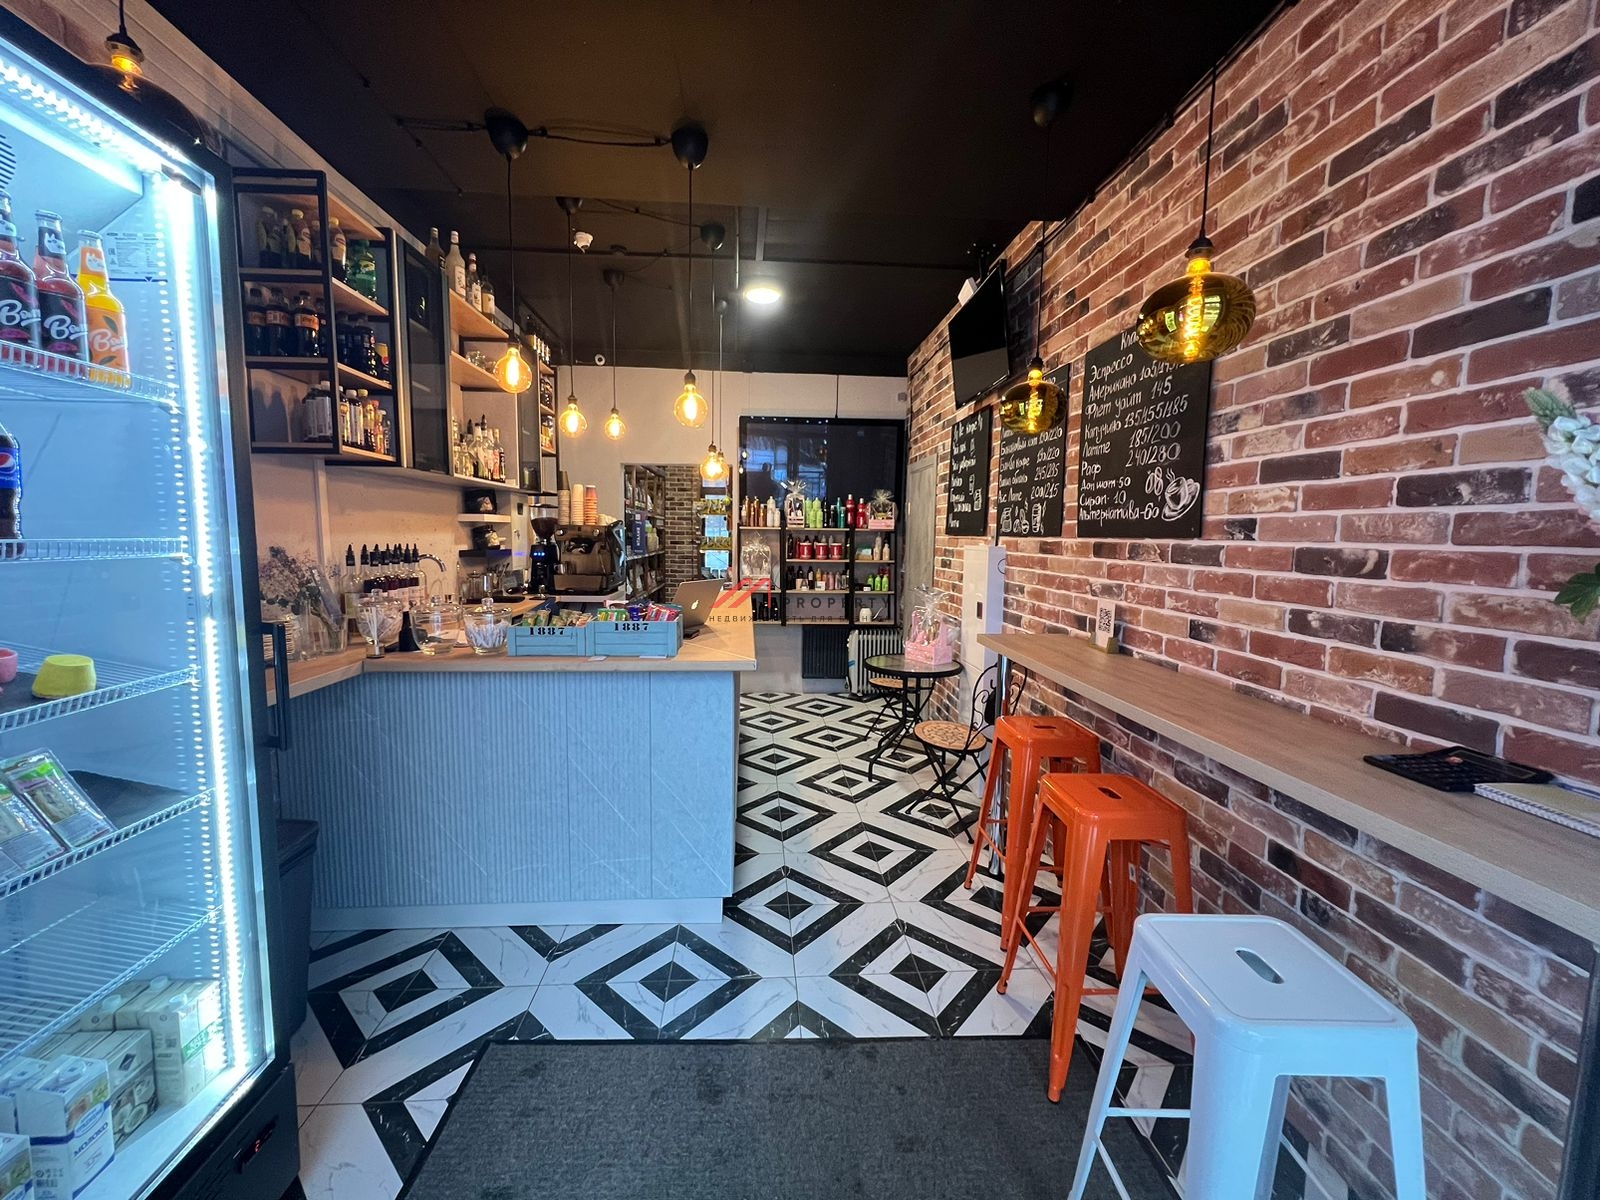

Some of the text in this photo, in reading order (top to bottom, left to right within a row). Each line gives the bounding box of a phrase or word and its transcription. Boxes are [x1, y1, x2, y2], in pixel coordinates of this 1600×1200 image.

[1089, 353, 1133, 384] Эспрессо
[1085, 375, 1173, 420] Флет уайт 145
[1088, 373, 1137, 403] Американо
[1124, 394, 1189, 428] 135/155/185
[1083, 421, 1181, 458] Латте 185/200
[1081, 442, 1181, 480] Раф 240/280
[1113, 489, 1127, 504] 10
[529, 627, 566, 636] 1887
[614, 622, 650, 632] 1887
